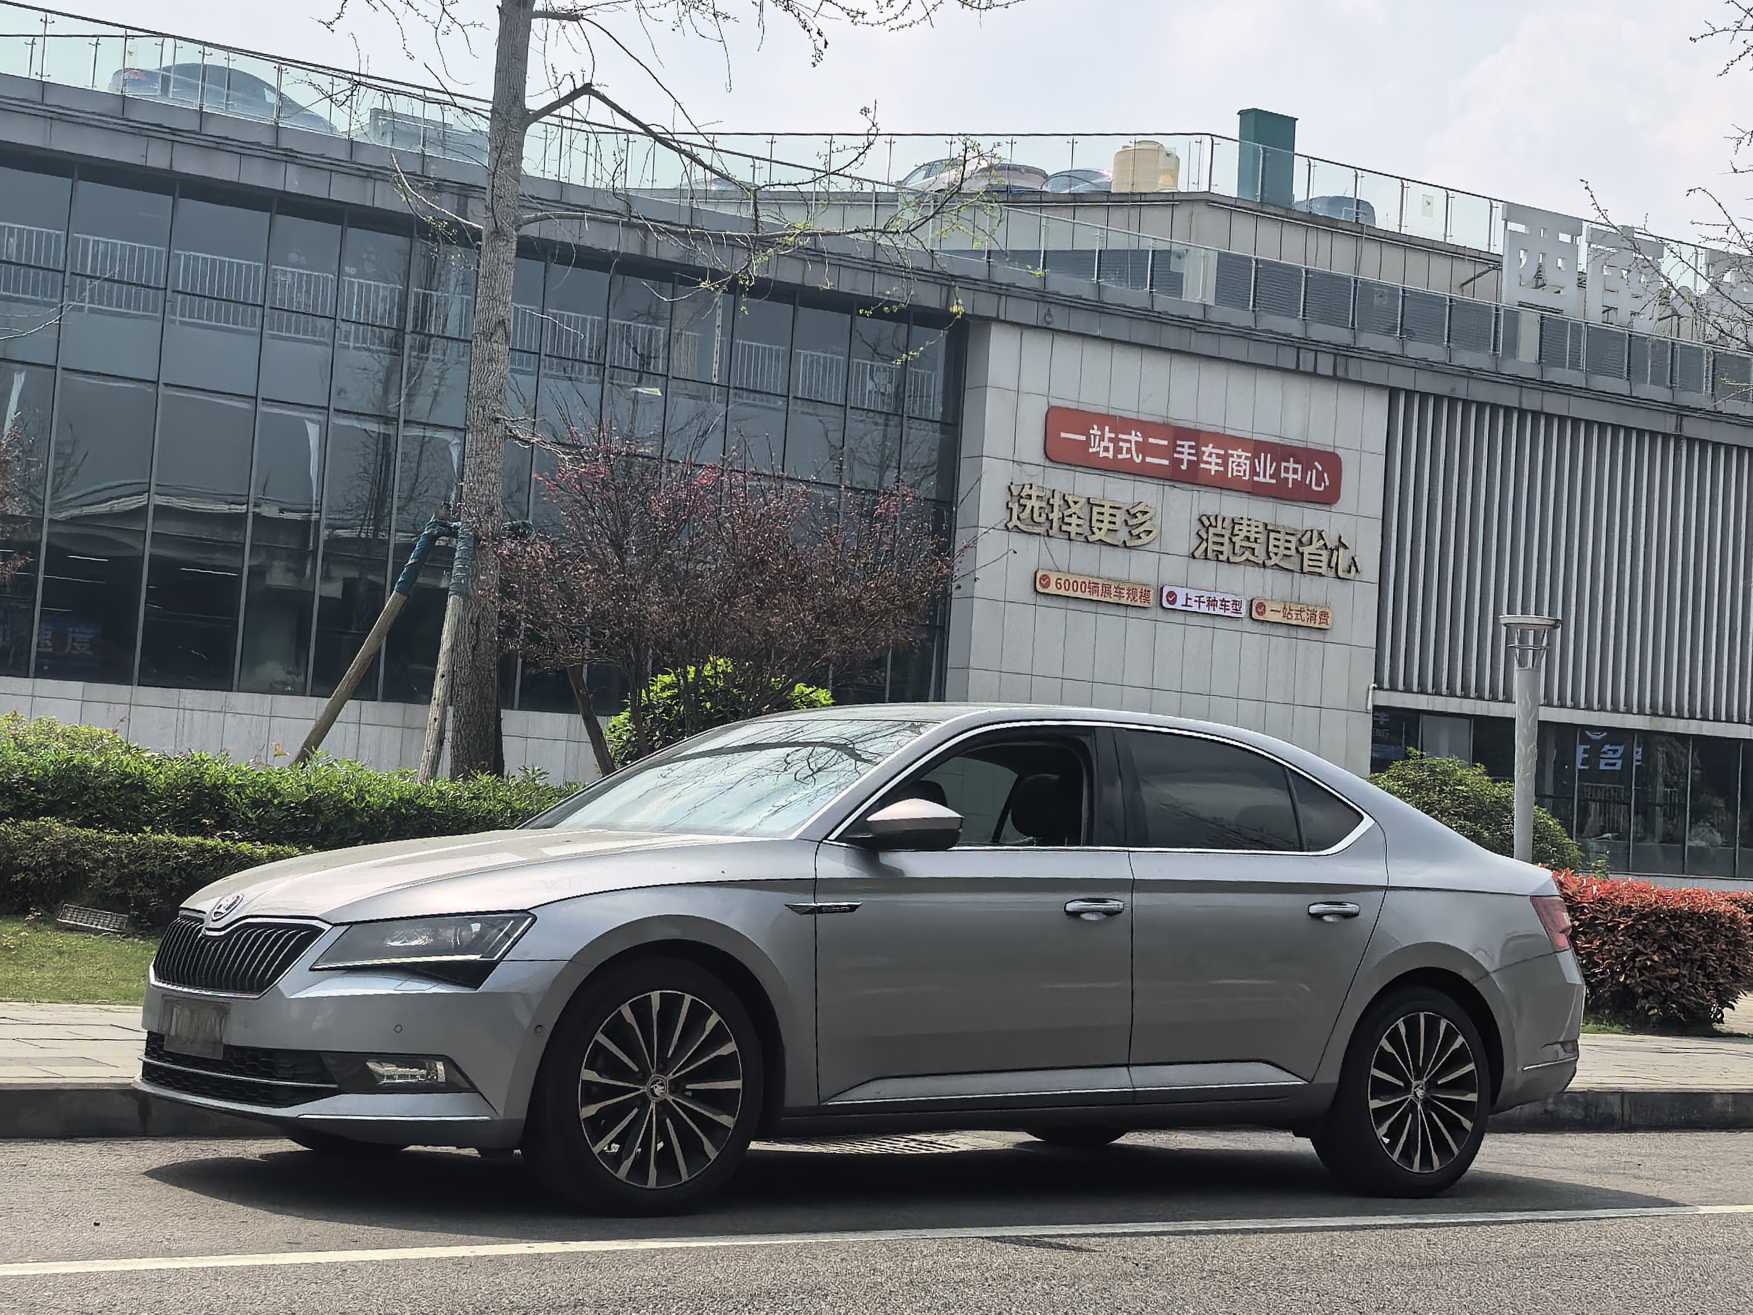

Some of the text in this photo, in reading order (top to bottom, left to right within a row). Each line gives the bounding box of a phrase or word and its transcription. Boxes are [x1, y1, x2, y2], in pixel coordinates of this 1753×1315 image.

[1060, 424, 1329, 492] 一站式二手车商业中心
[1005, 482, 1360, 579] 选择更多 消费更省心
[1055, 577, 1152, 604] 6000辆展车规模
[1181, 593, 1243, 615] 上千种车型
[1270, 602, 1330, 626] 一站式消费
